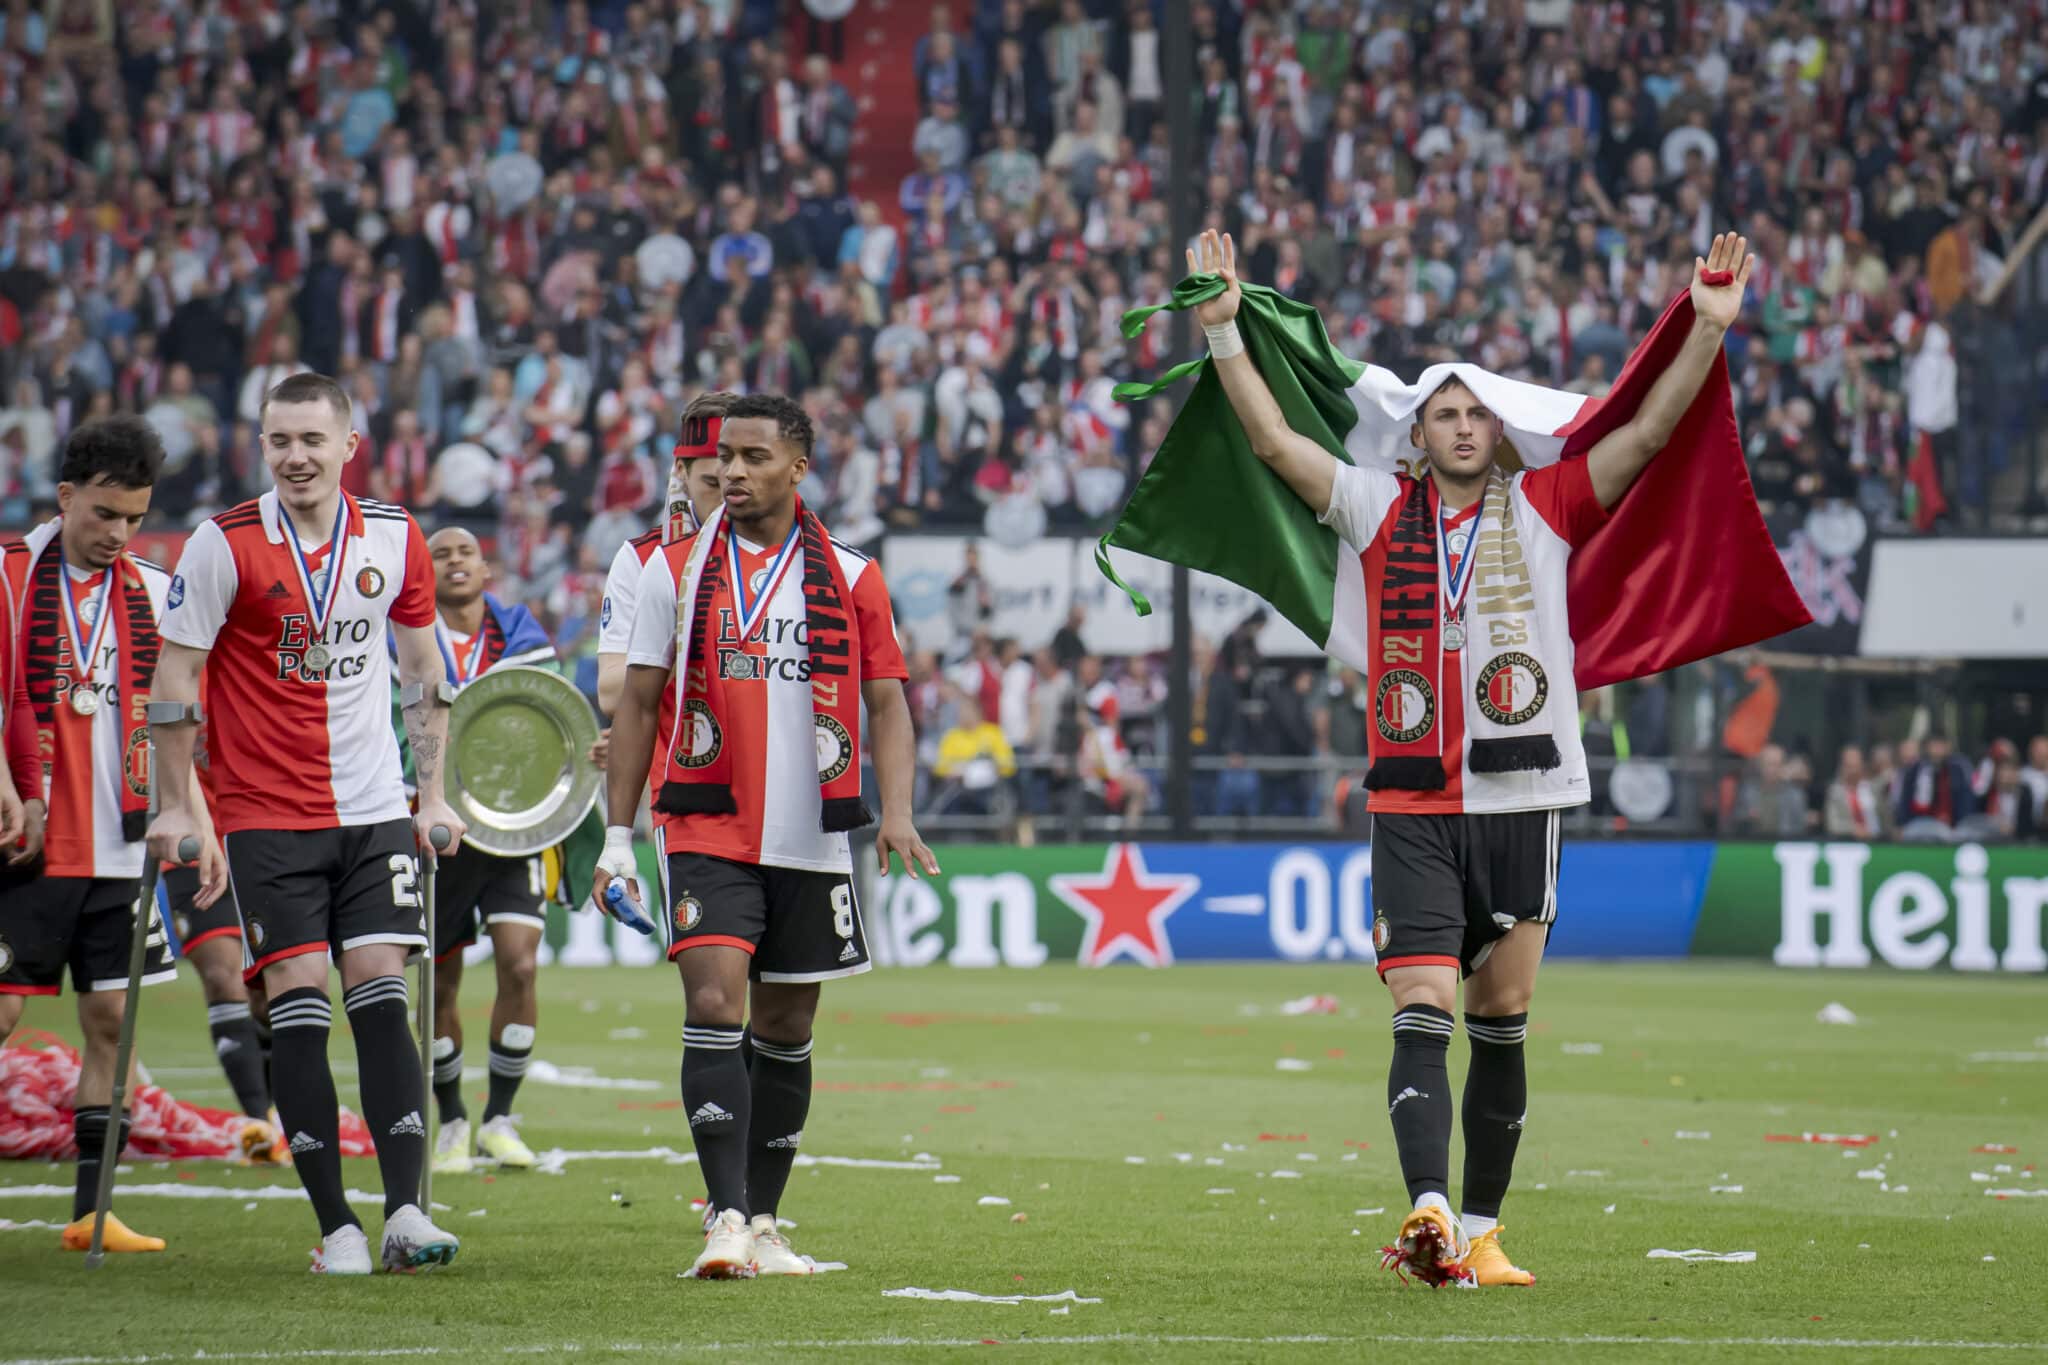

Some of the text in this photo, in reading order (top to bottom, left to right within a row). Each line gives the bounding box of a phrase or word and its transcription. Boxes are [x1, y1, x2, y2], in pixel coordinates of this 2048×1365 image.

[1489, 618, 1529, 647] 23
[1383, 635, 1423, 663] 22
[1480, 653, 1544, 684] FEYENOORD
[1479, 694, 1545, 724] ROTTERDAM
[829, 883, 854, 939] 8
